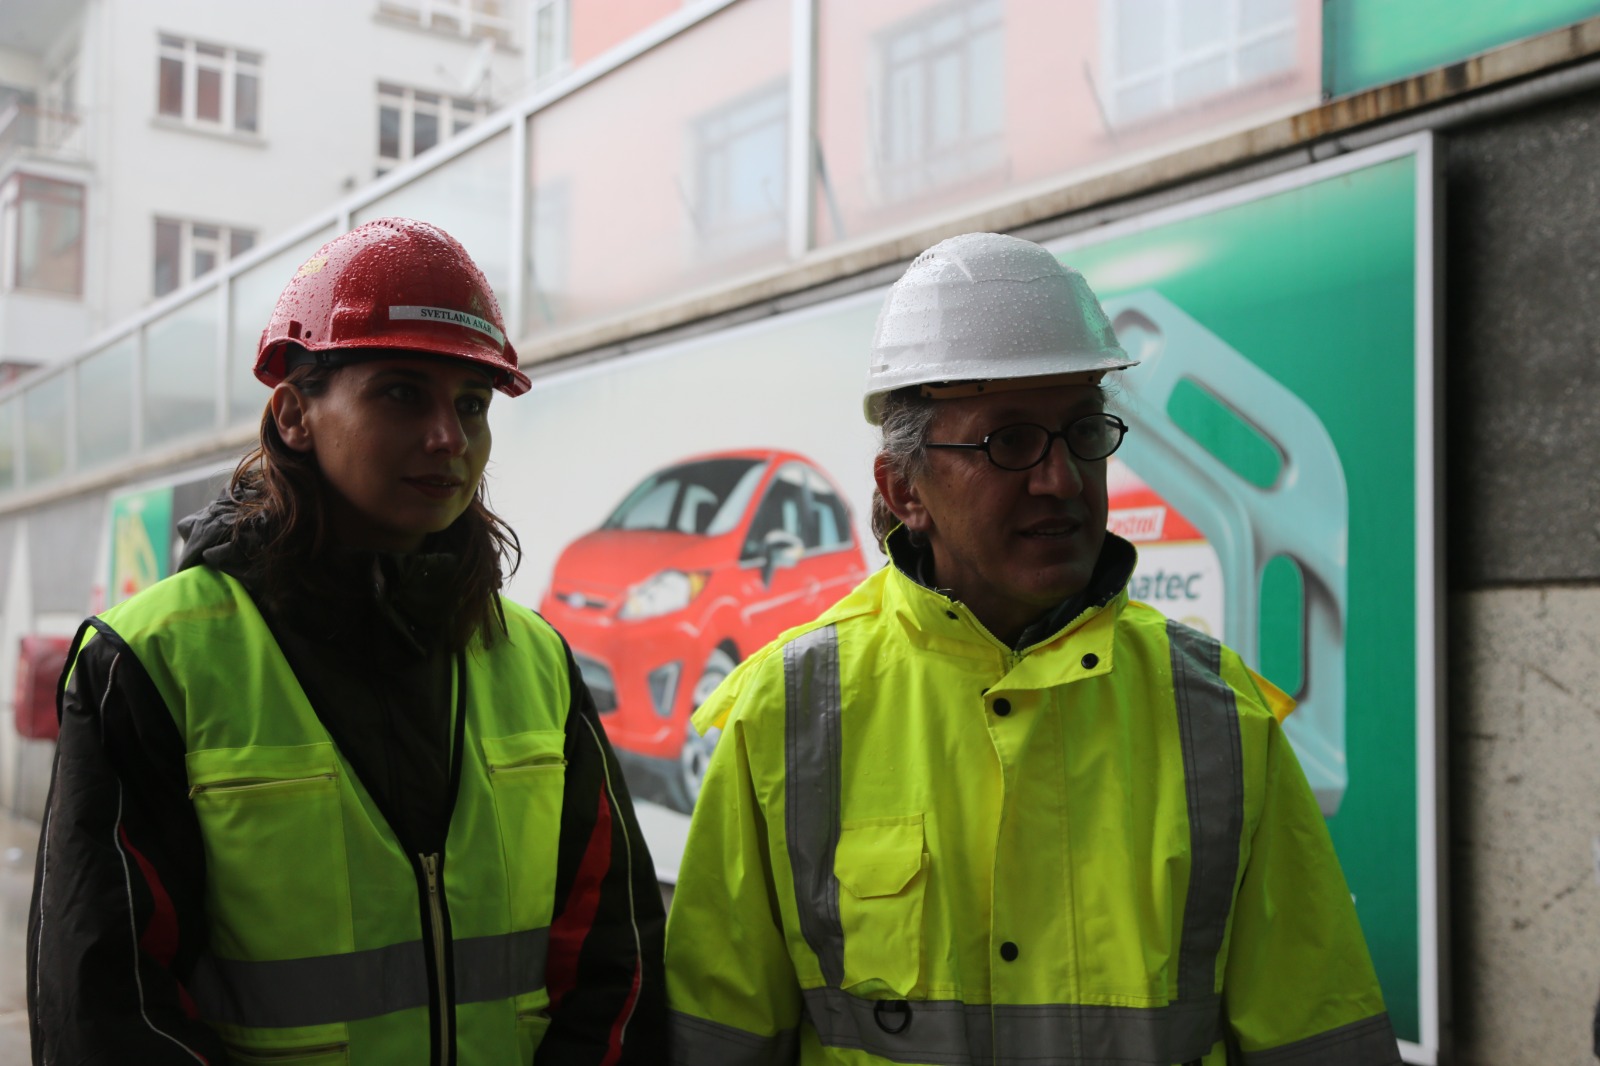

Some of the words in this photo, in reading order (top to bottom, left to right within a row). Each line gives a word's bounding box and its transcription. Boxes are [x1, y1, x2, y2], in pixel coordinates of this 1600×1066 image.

[421, 308, 471, 325] SVETLANA
[473, 319, 492, 334] ANAR
[1109, 514, 1159, 535] astrol
